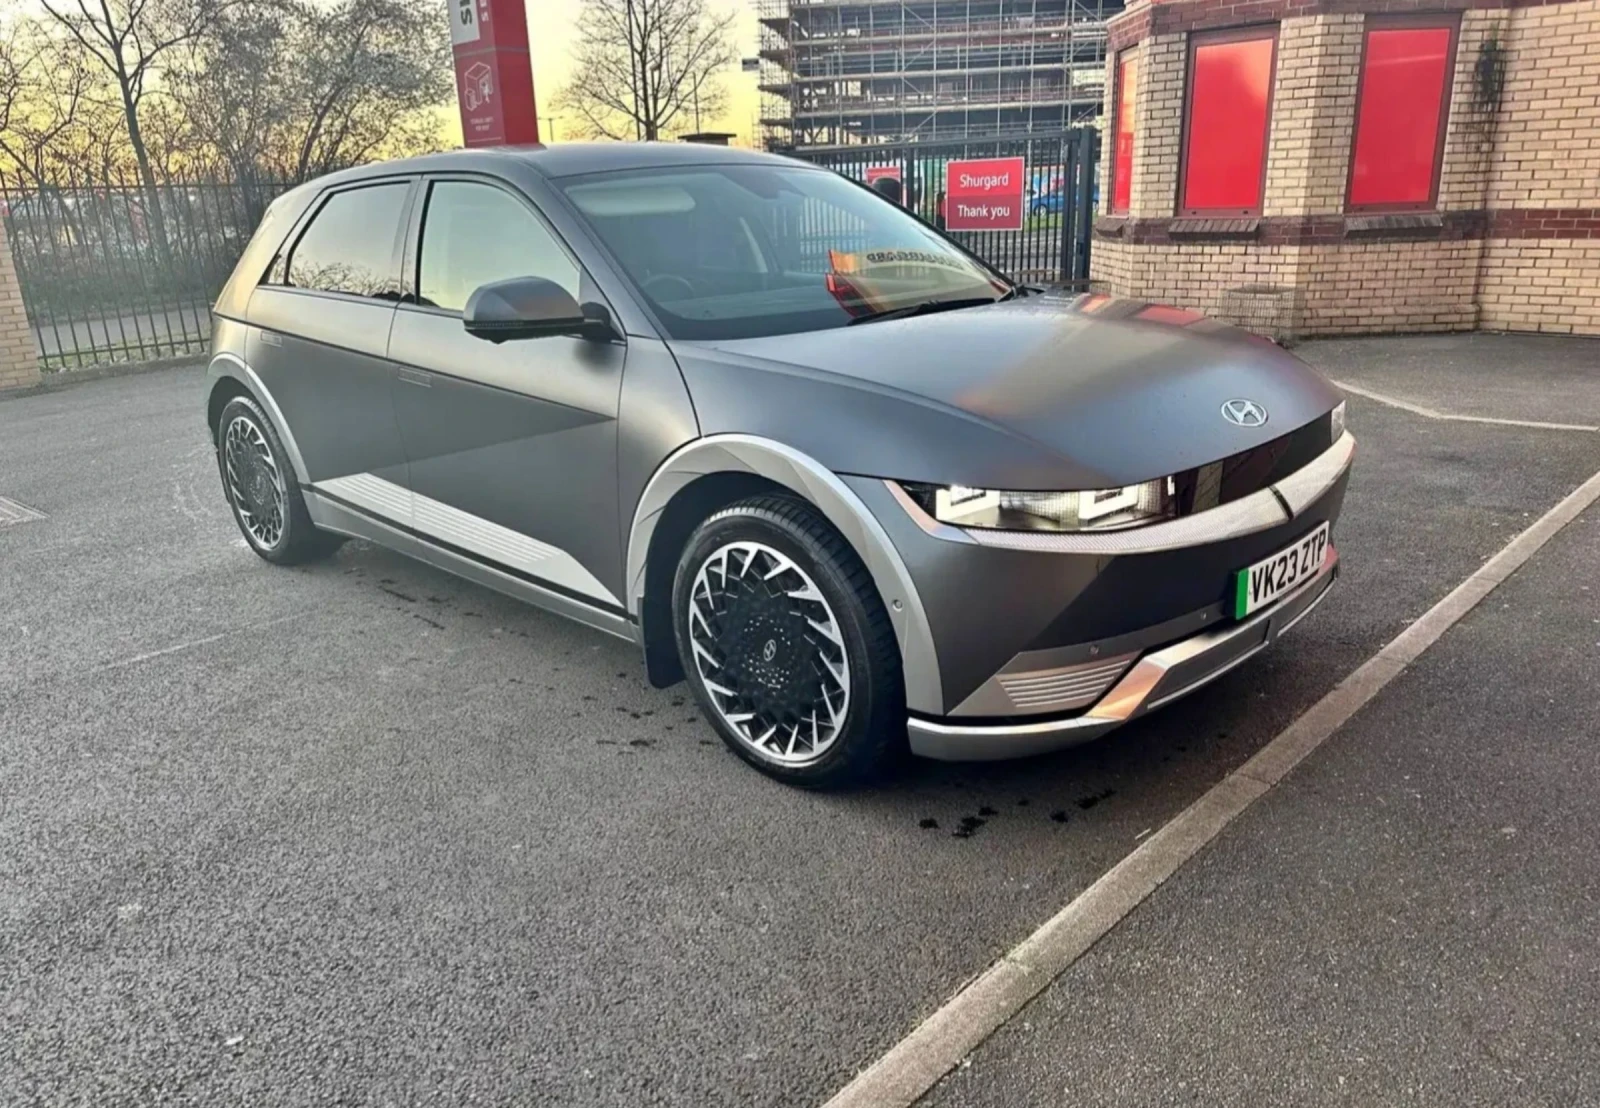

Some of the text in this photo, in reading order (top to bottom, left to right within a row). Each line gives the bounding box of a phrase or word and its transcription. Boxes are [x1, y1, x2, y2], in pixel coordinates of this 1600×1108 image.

[960, 172, 1009, 191] Shurgard
[957, 204, 1010, 220] Thank you
[1251, 528, 1327, 603] VK23 ZTP
